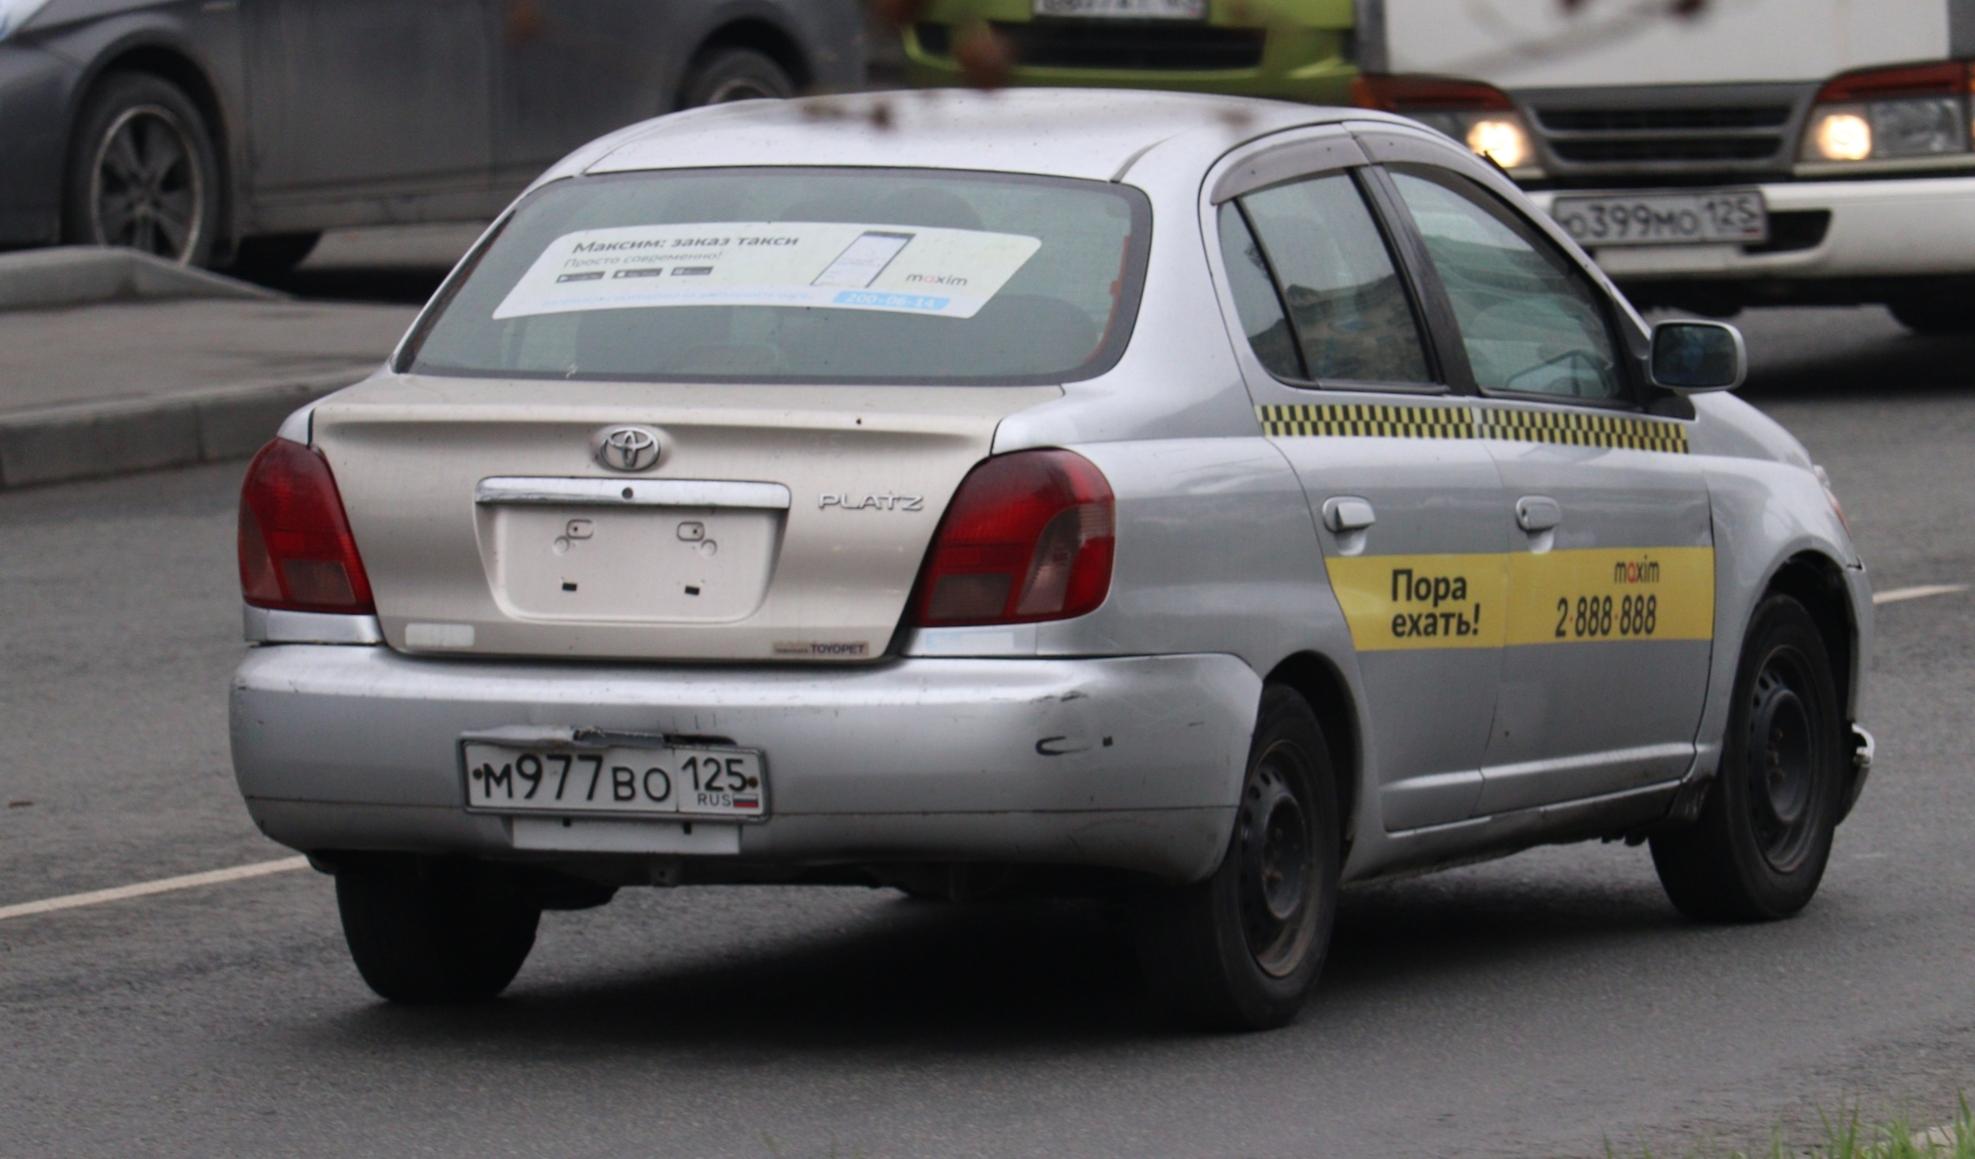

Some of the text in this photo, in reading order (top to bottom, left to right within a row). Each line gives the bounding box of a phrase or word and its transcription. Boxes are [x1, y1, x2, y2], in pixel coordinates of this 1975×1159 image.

[1706, 197, 1759, 226] 125
[572, 235, 799, 254] Максим: заказ такси
[564, 251, 723, 269] Просто современно!
[905, 273, 968, 286] maxim
[818, 492, 923, 512] PLATZ
[1614, 555, 1660, 584] maxim
[1391, 568, 1467, 606] Пора
[1391, 602, 1480, 638] ехать!
[810, 644, 864, 654] TOYOPET
[681, 756, 747, 791] 125
[697, 793, 731, 806] RUS
